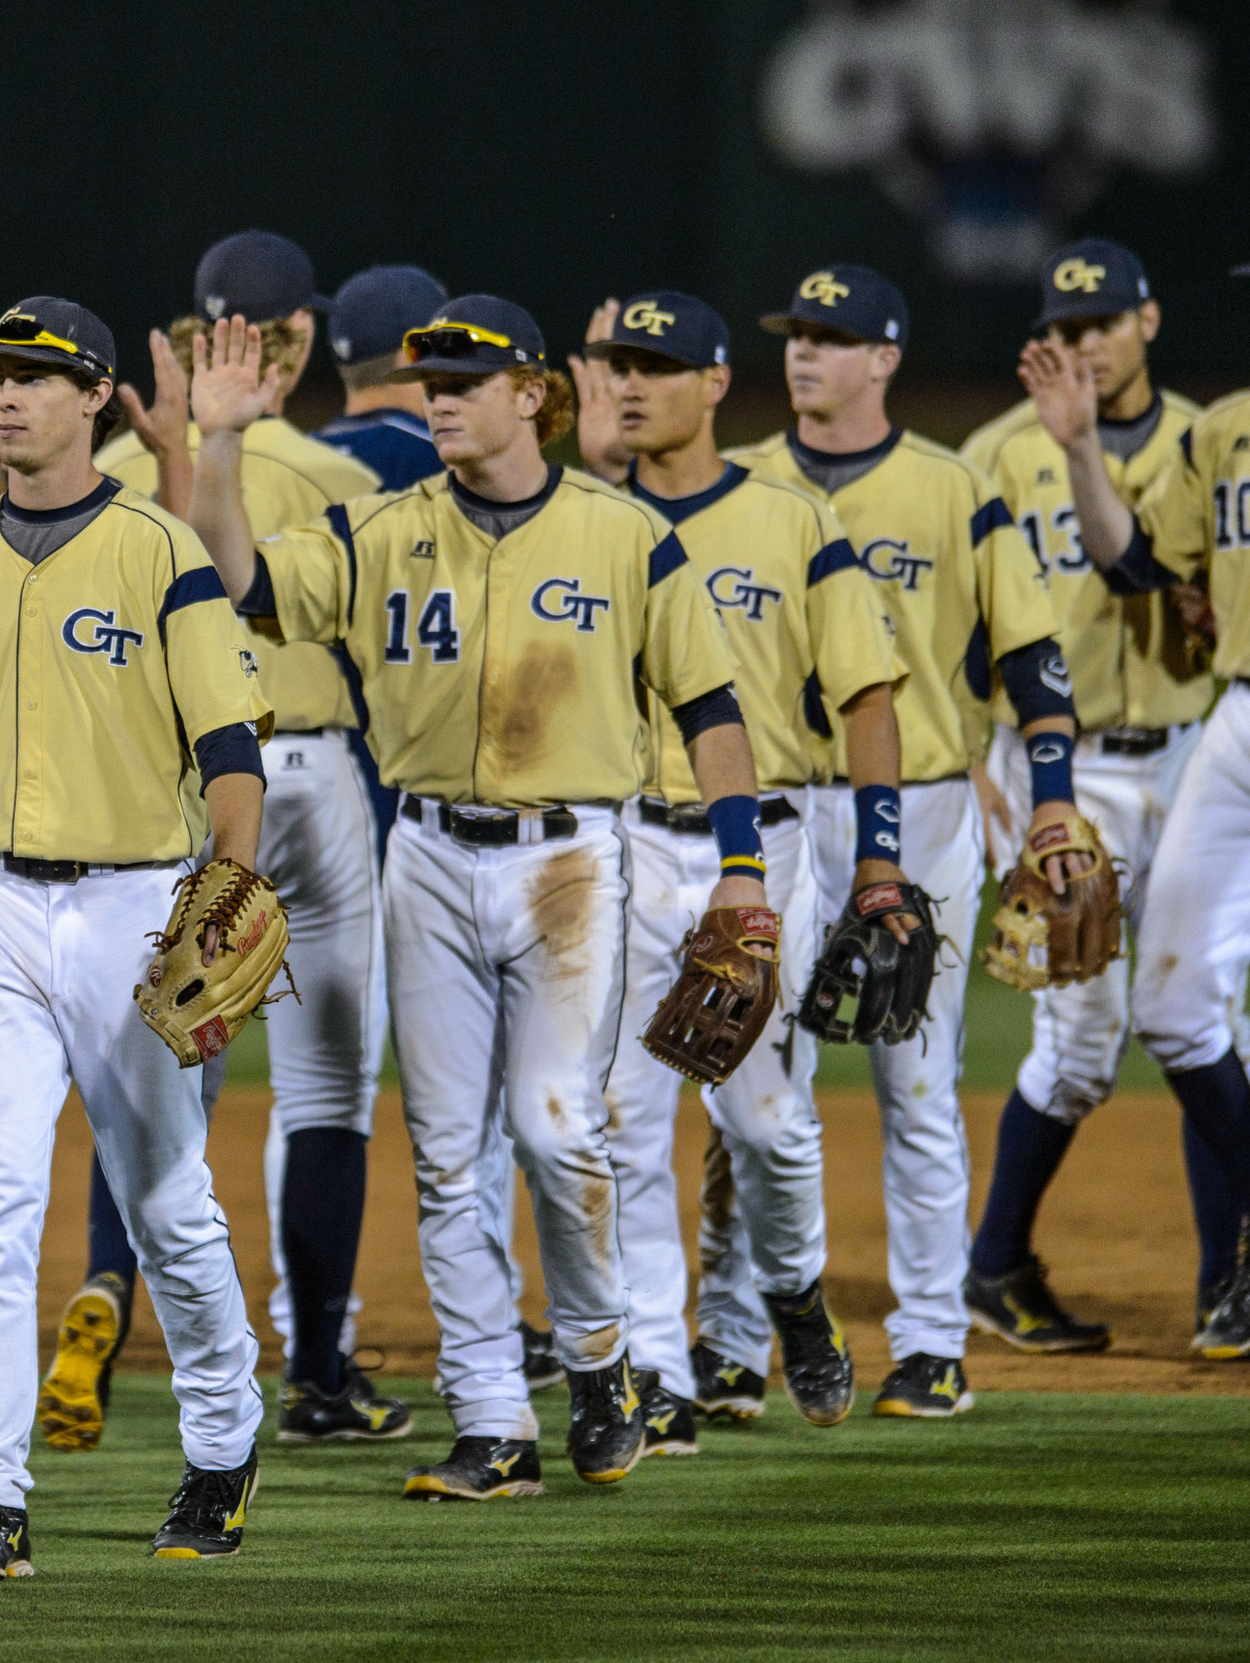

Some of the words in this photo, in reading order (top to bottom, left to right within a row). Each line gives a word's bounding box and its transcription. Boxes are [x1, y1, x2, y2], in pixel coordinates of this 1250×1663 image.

[800, 272, 849, 306] GT
[1054, 258, 1106, 292] GT
[623, 301, 675, 336] GT
[860, 538, 935, 592] GT
[1018, 506, 1093, 576] 13
[530, 576, 611, 633] GT
[705, 566, 782, 621] GT
[61, 607, 144, 667] GT
[384, 590, 460, 664] 14
[237, 909, 266, 957] Rawlings
